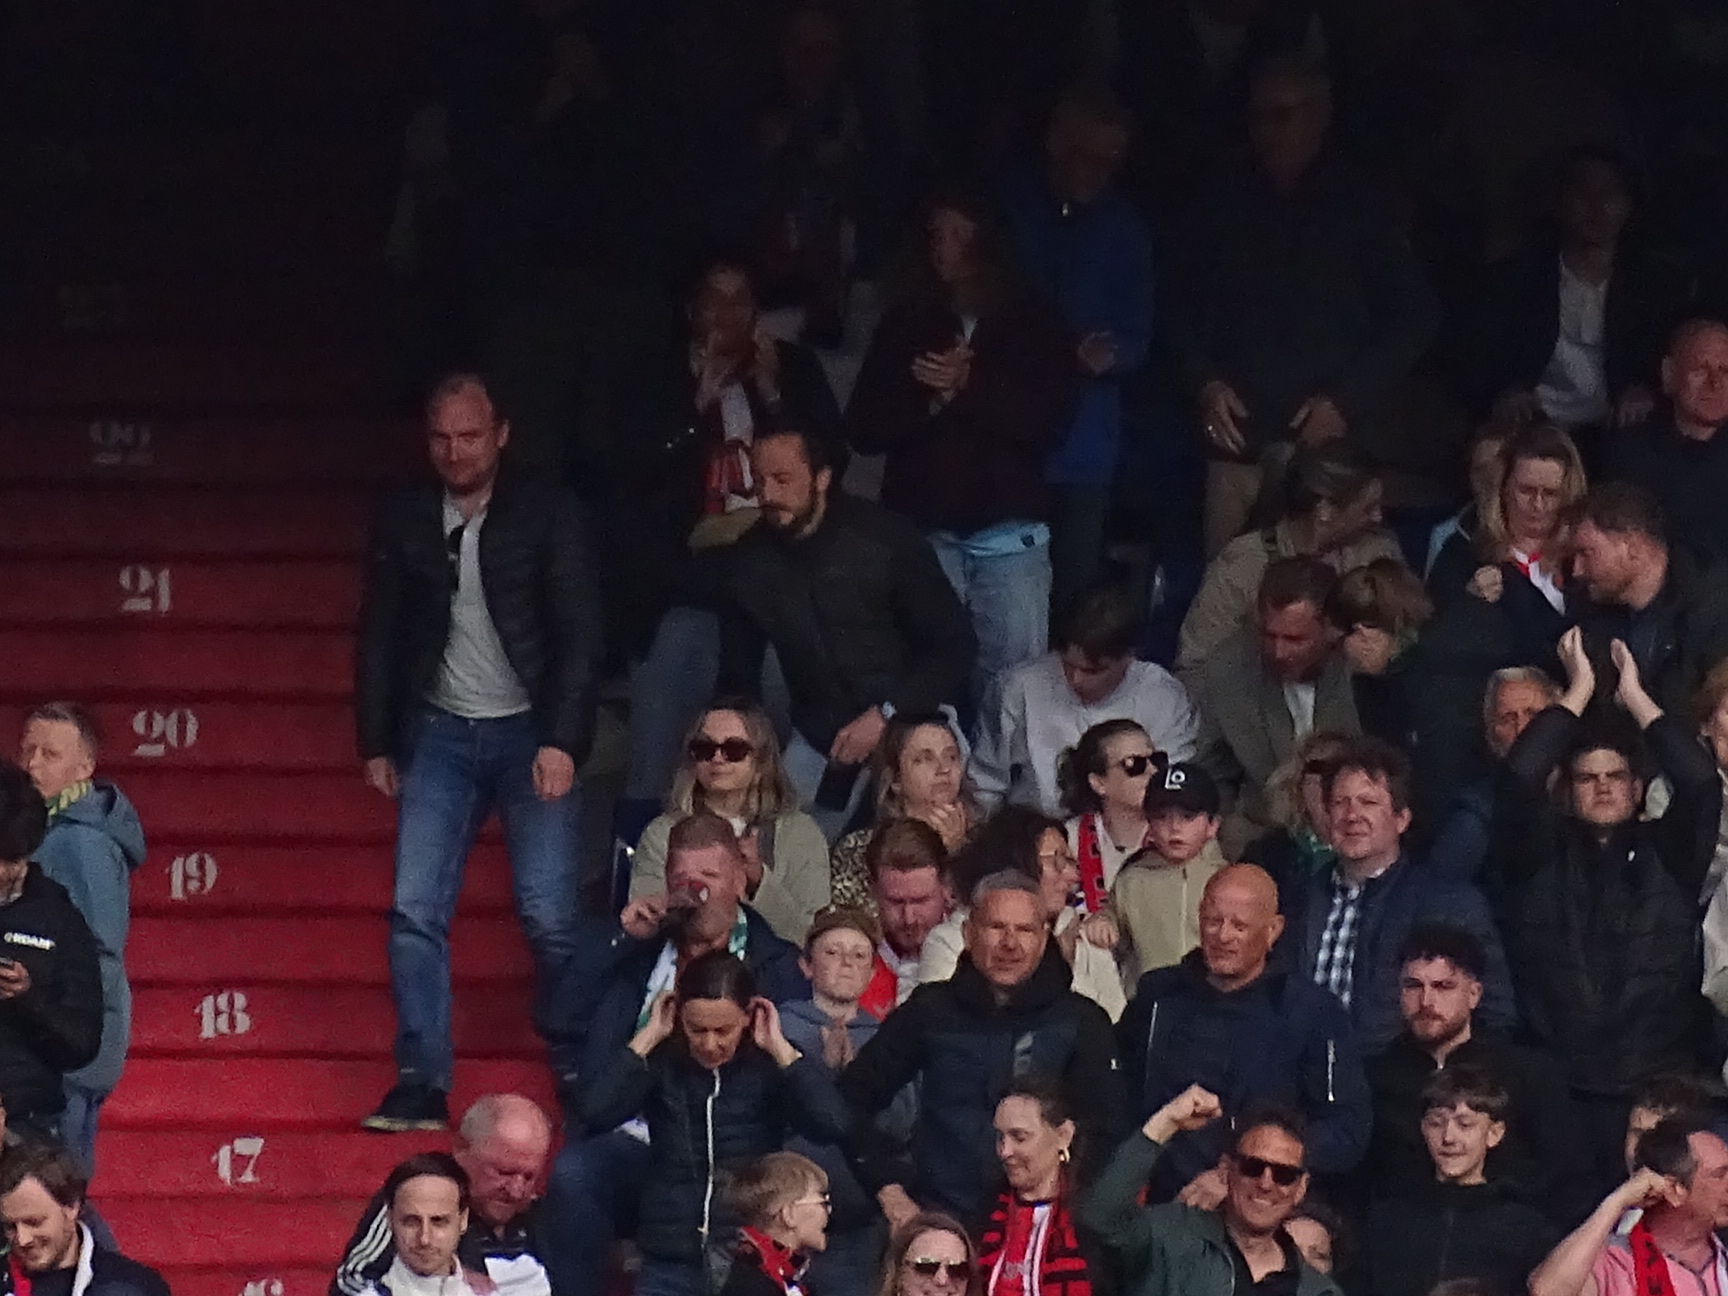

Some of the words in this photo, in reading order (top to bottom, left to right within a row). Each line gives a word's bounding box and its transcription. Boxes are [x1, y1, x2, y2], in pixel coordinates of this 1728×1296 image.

[118, 564, 171, 614] 21
[131, 708, 199, 757] 20
[166, 851, 219, 901] 19
[194, 990, 252, 1040] 18
[212, 1136, 265, 1187] 17
